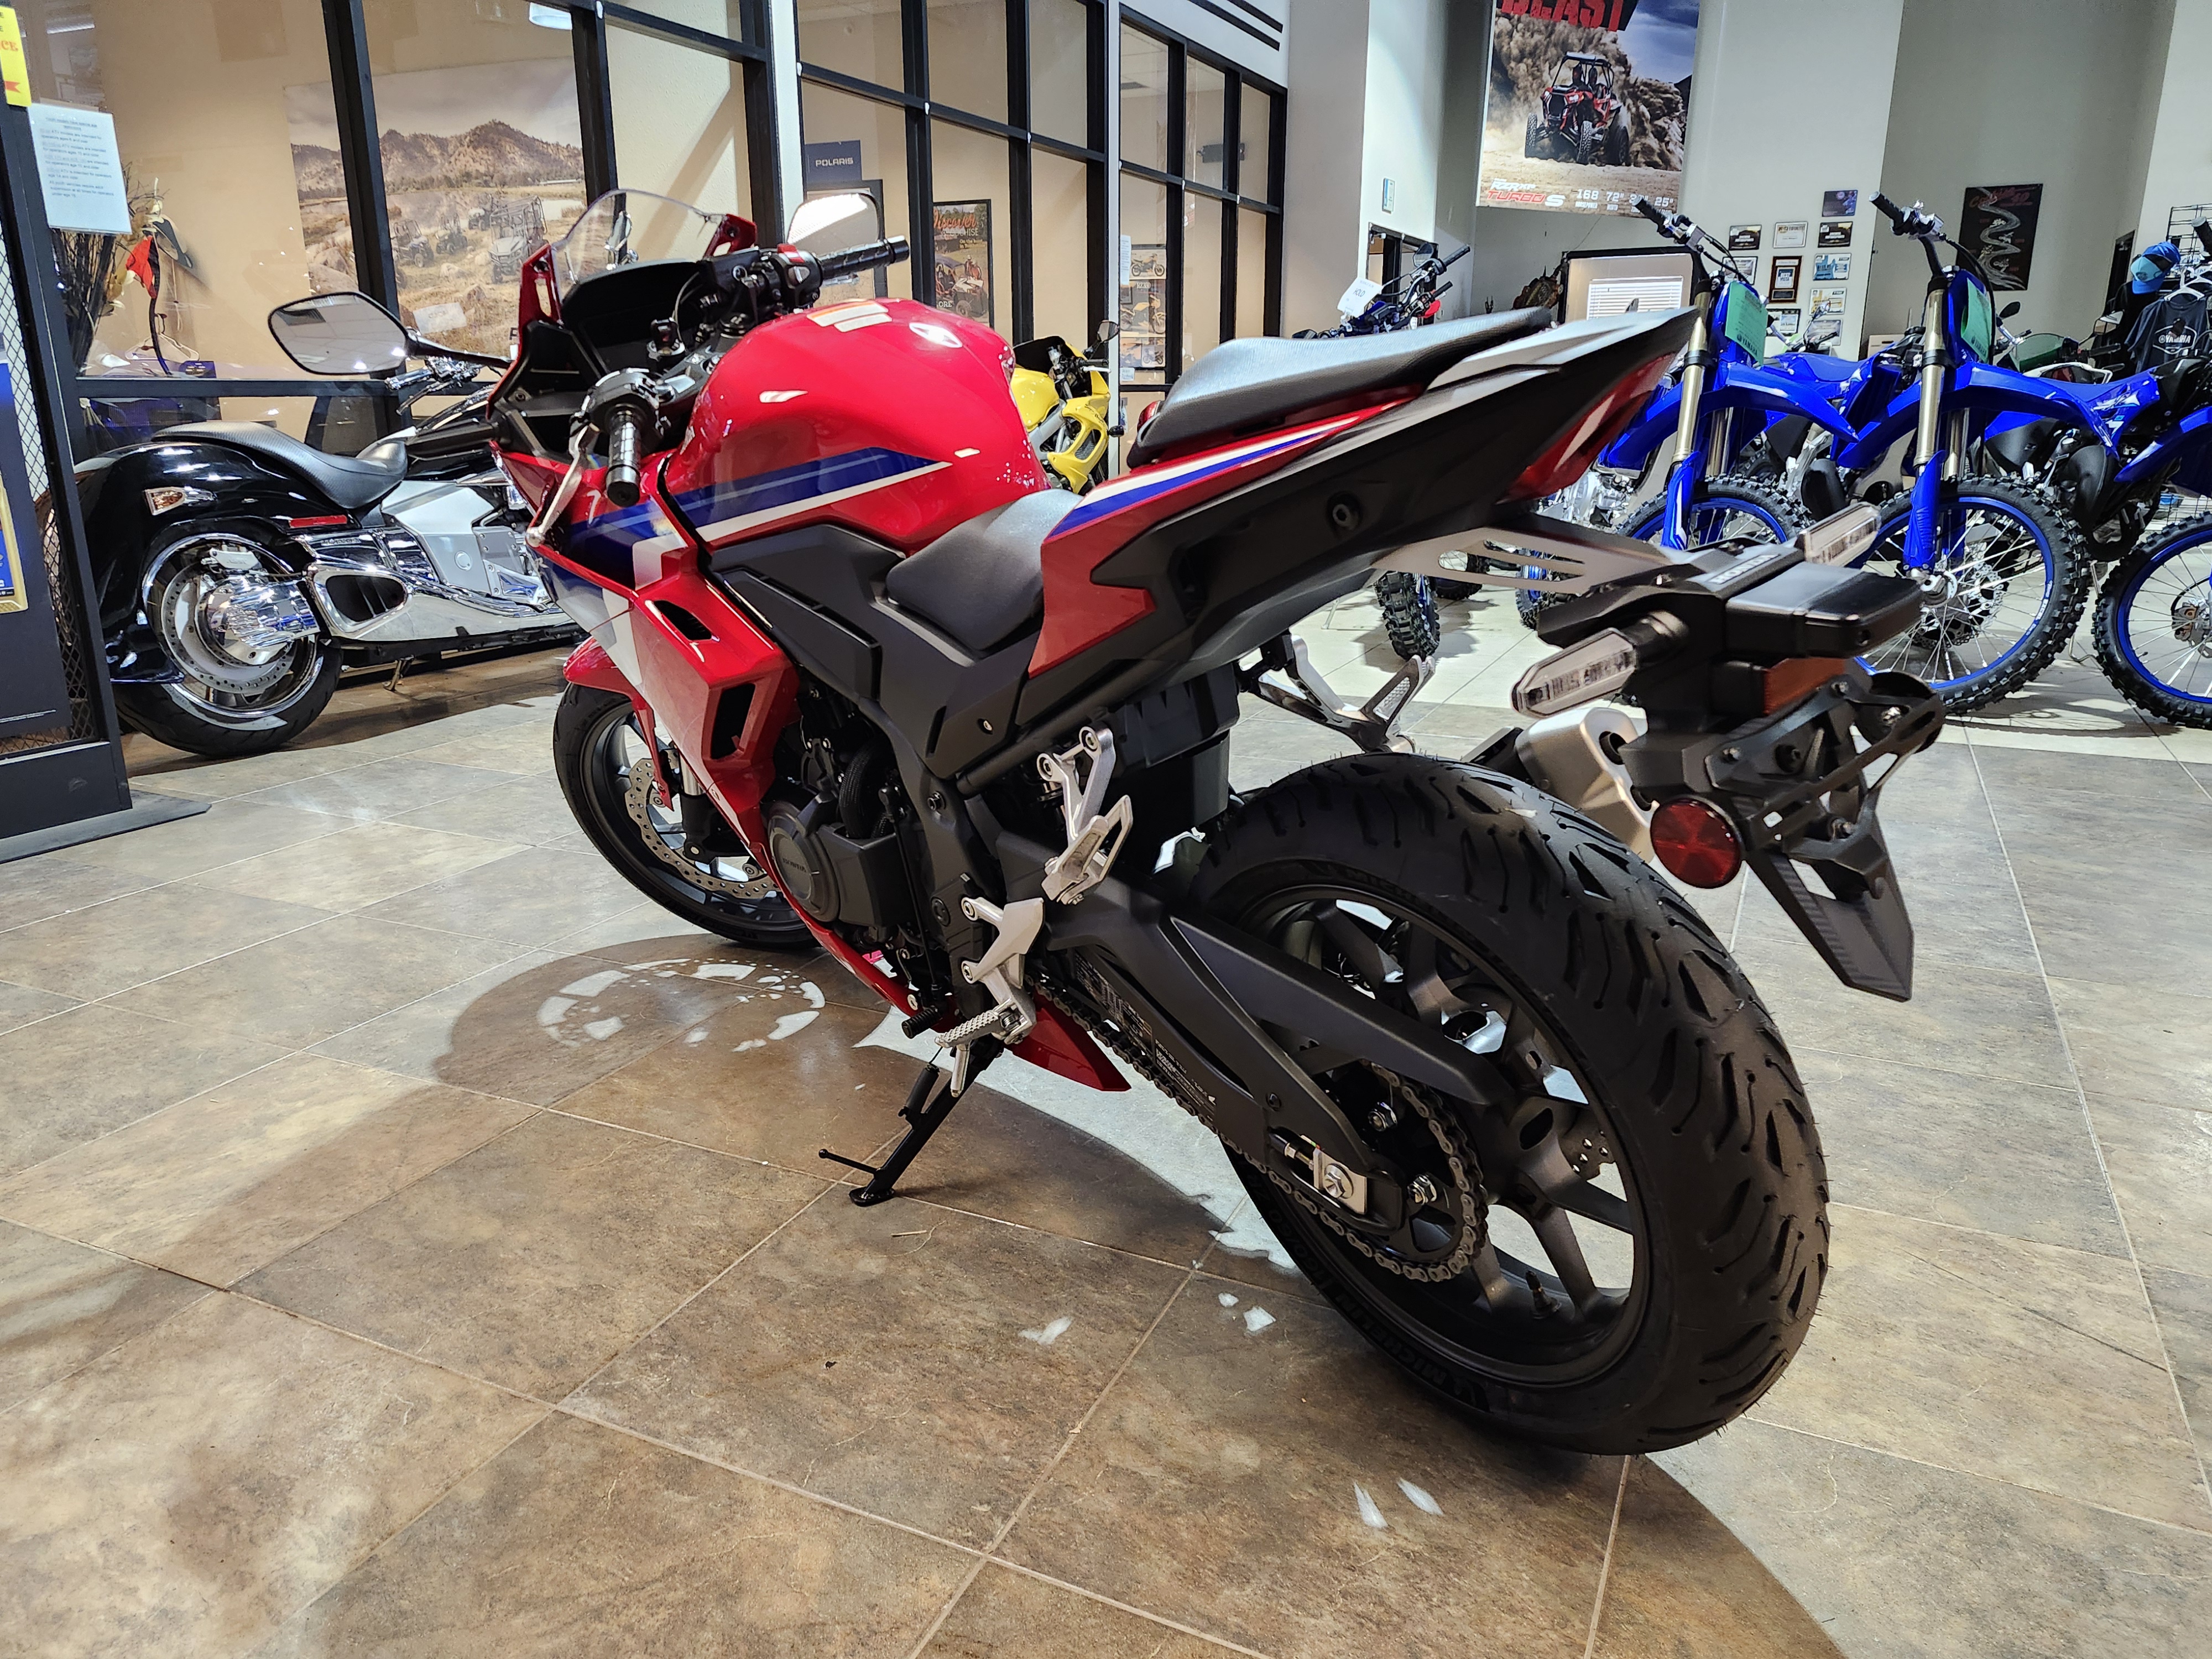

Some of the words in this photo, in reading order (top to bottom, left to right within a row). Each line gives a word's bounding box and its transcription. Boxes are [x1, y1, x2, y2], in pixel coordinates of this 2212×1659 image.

[816, 158, 853, 166] POLARIS
[1486, 190, 1546, 204] TURBO
[1545, 195, 1566, 207] S
[1577, 189, 1599, 200] 168
[1606, 191, 1624, 202] 72"
[1654, 197, 1674, 207] 25"
[1708, 554, 1779, 585] HONDA
[1333, 1293, 1447, 1386] MICHELIN
